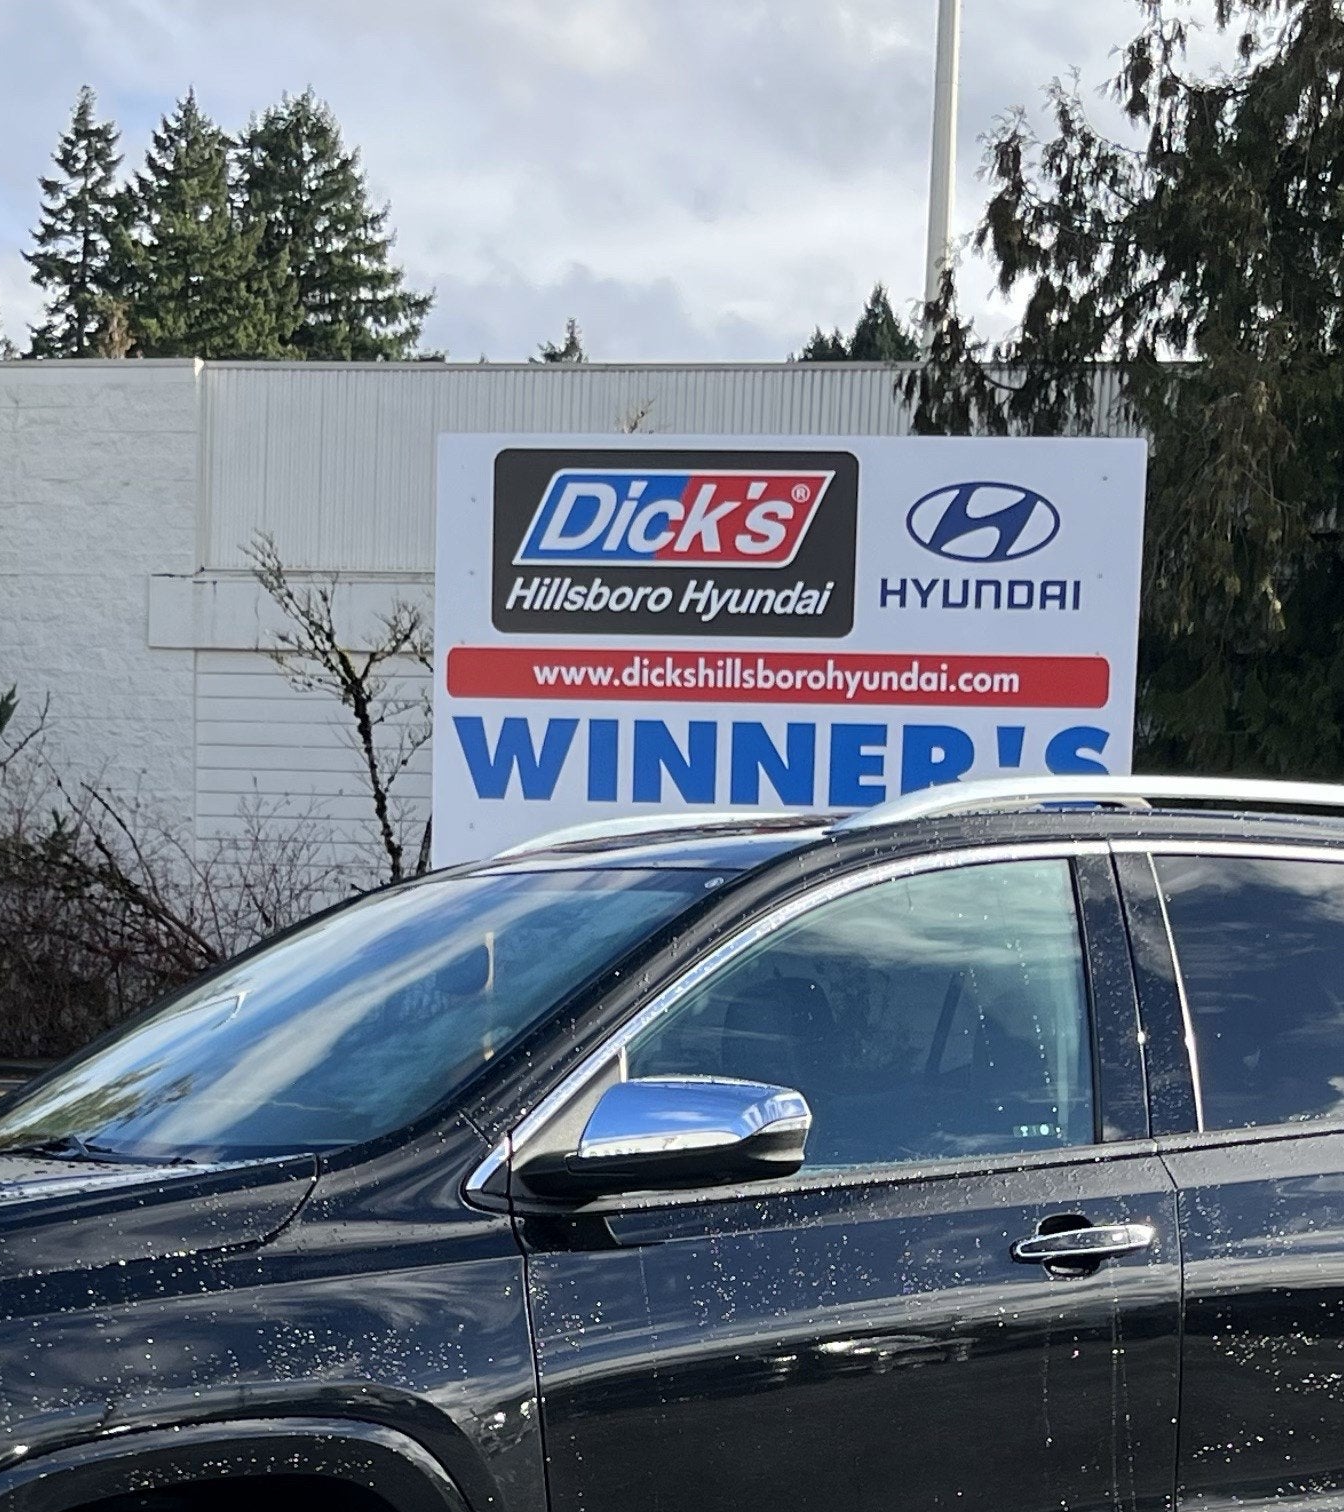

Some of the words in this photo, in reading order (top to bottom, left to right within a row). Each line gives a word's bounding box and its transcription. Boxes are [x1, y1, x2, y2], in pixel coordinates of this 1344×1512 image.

[539, 481, 793, 553] Dick's
[505, 576, 672, 612] Hillsboro
[678, 580, 834, 622] Hyundai
[879, 577, 1081, 611] HYUNDAI
[532, 656, 1020, 698] www.dickshillsborohyundai.com
